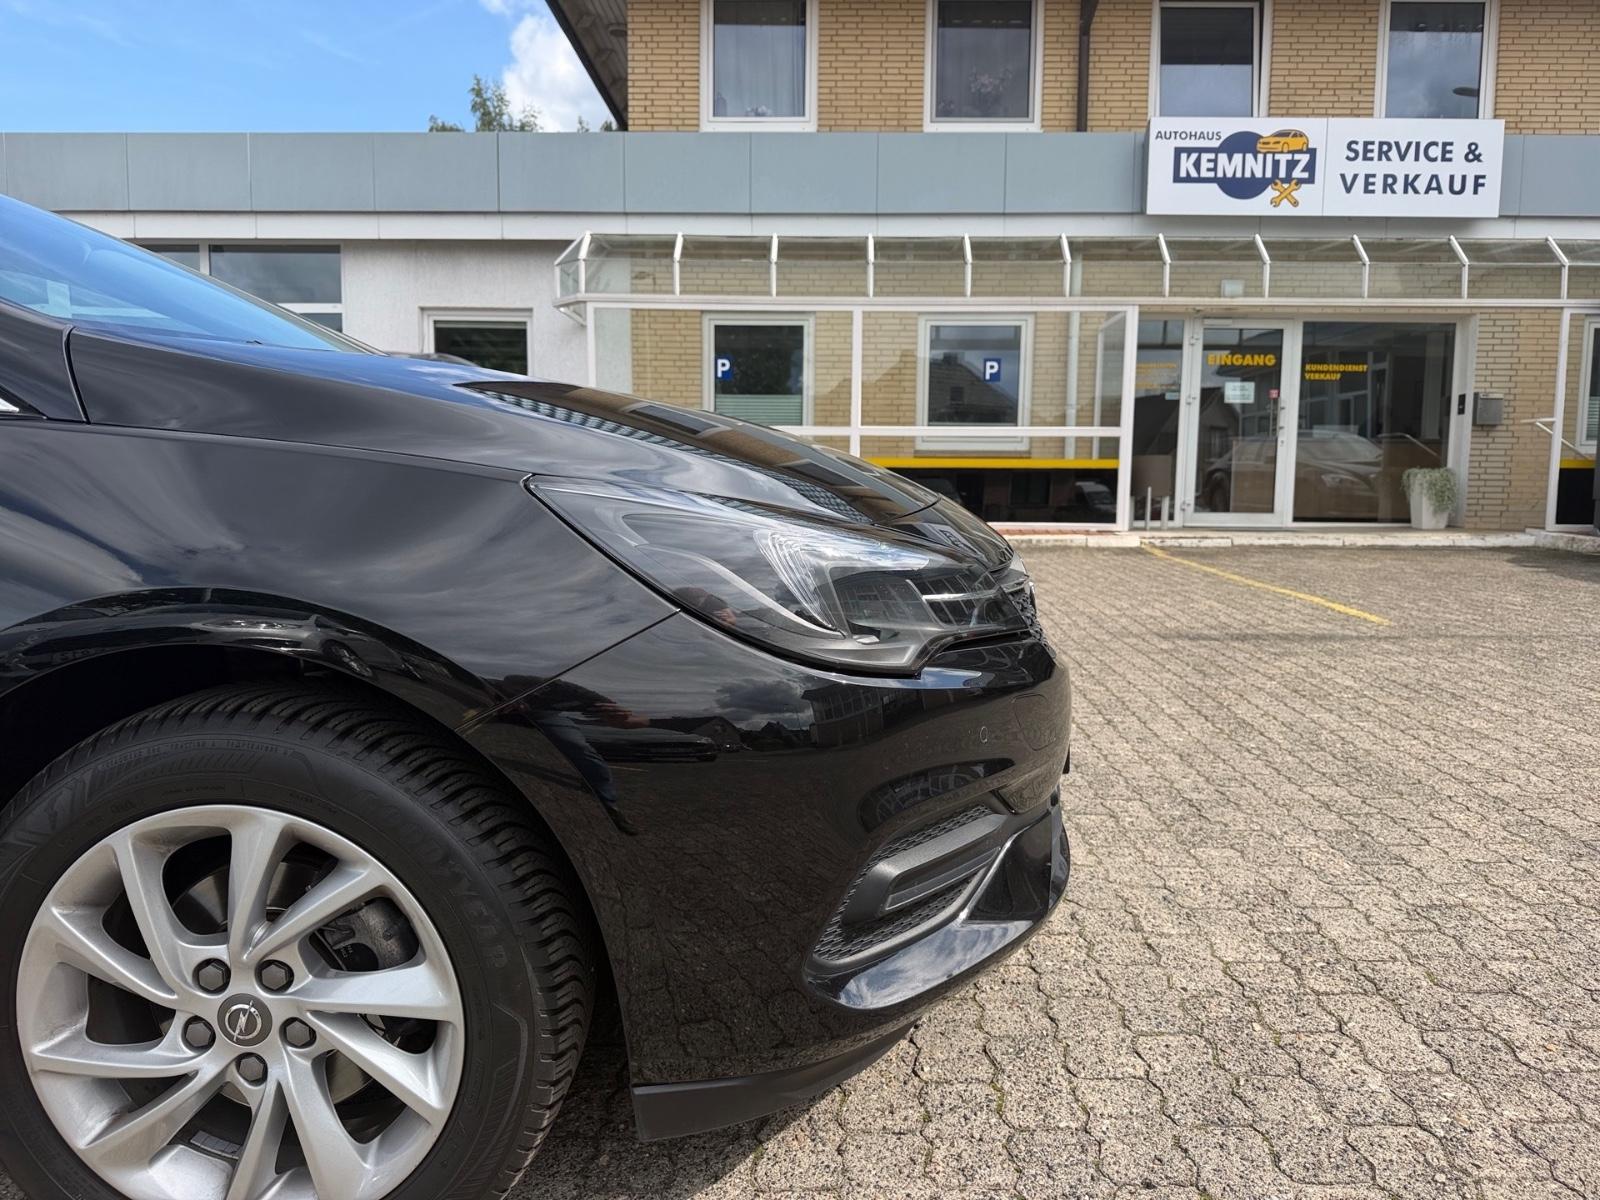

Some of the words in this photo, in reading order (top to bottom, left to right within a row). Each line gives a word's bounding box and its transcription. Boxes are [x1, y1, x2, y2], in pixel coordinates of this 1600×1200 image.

[1155, 130, 1222, 141] AUTOHAUS
[1345, 140, 1453, 162] SERVICE
[1464, 142, 1483, 163] &
[1179, 152, 1311, 179] KEMNITZ
[1340, 173, 1487, 196] VERKAUF
[717, 358, 731, 378] P
[985, 360, 999, 380] P
[1207, 353, 1277, 367] EINGANG
[1304, 363, 1368, 372] KUNDENDIENST
[1304, 372, 1341, 380] VERKAUF
